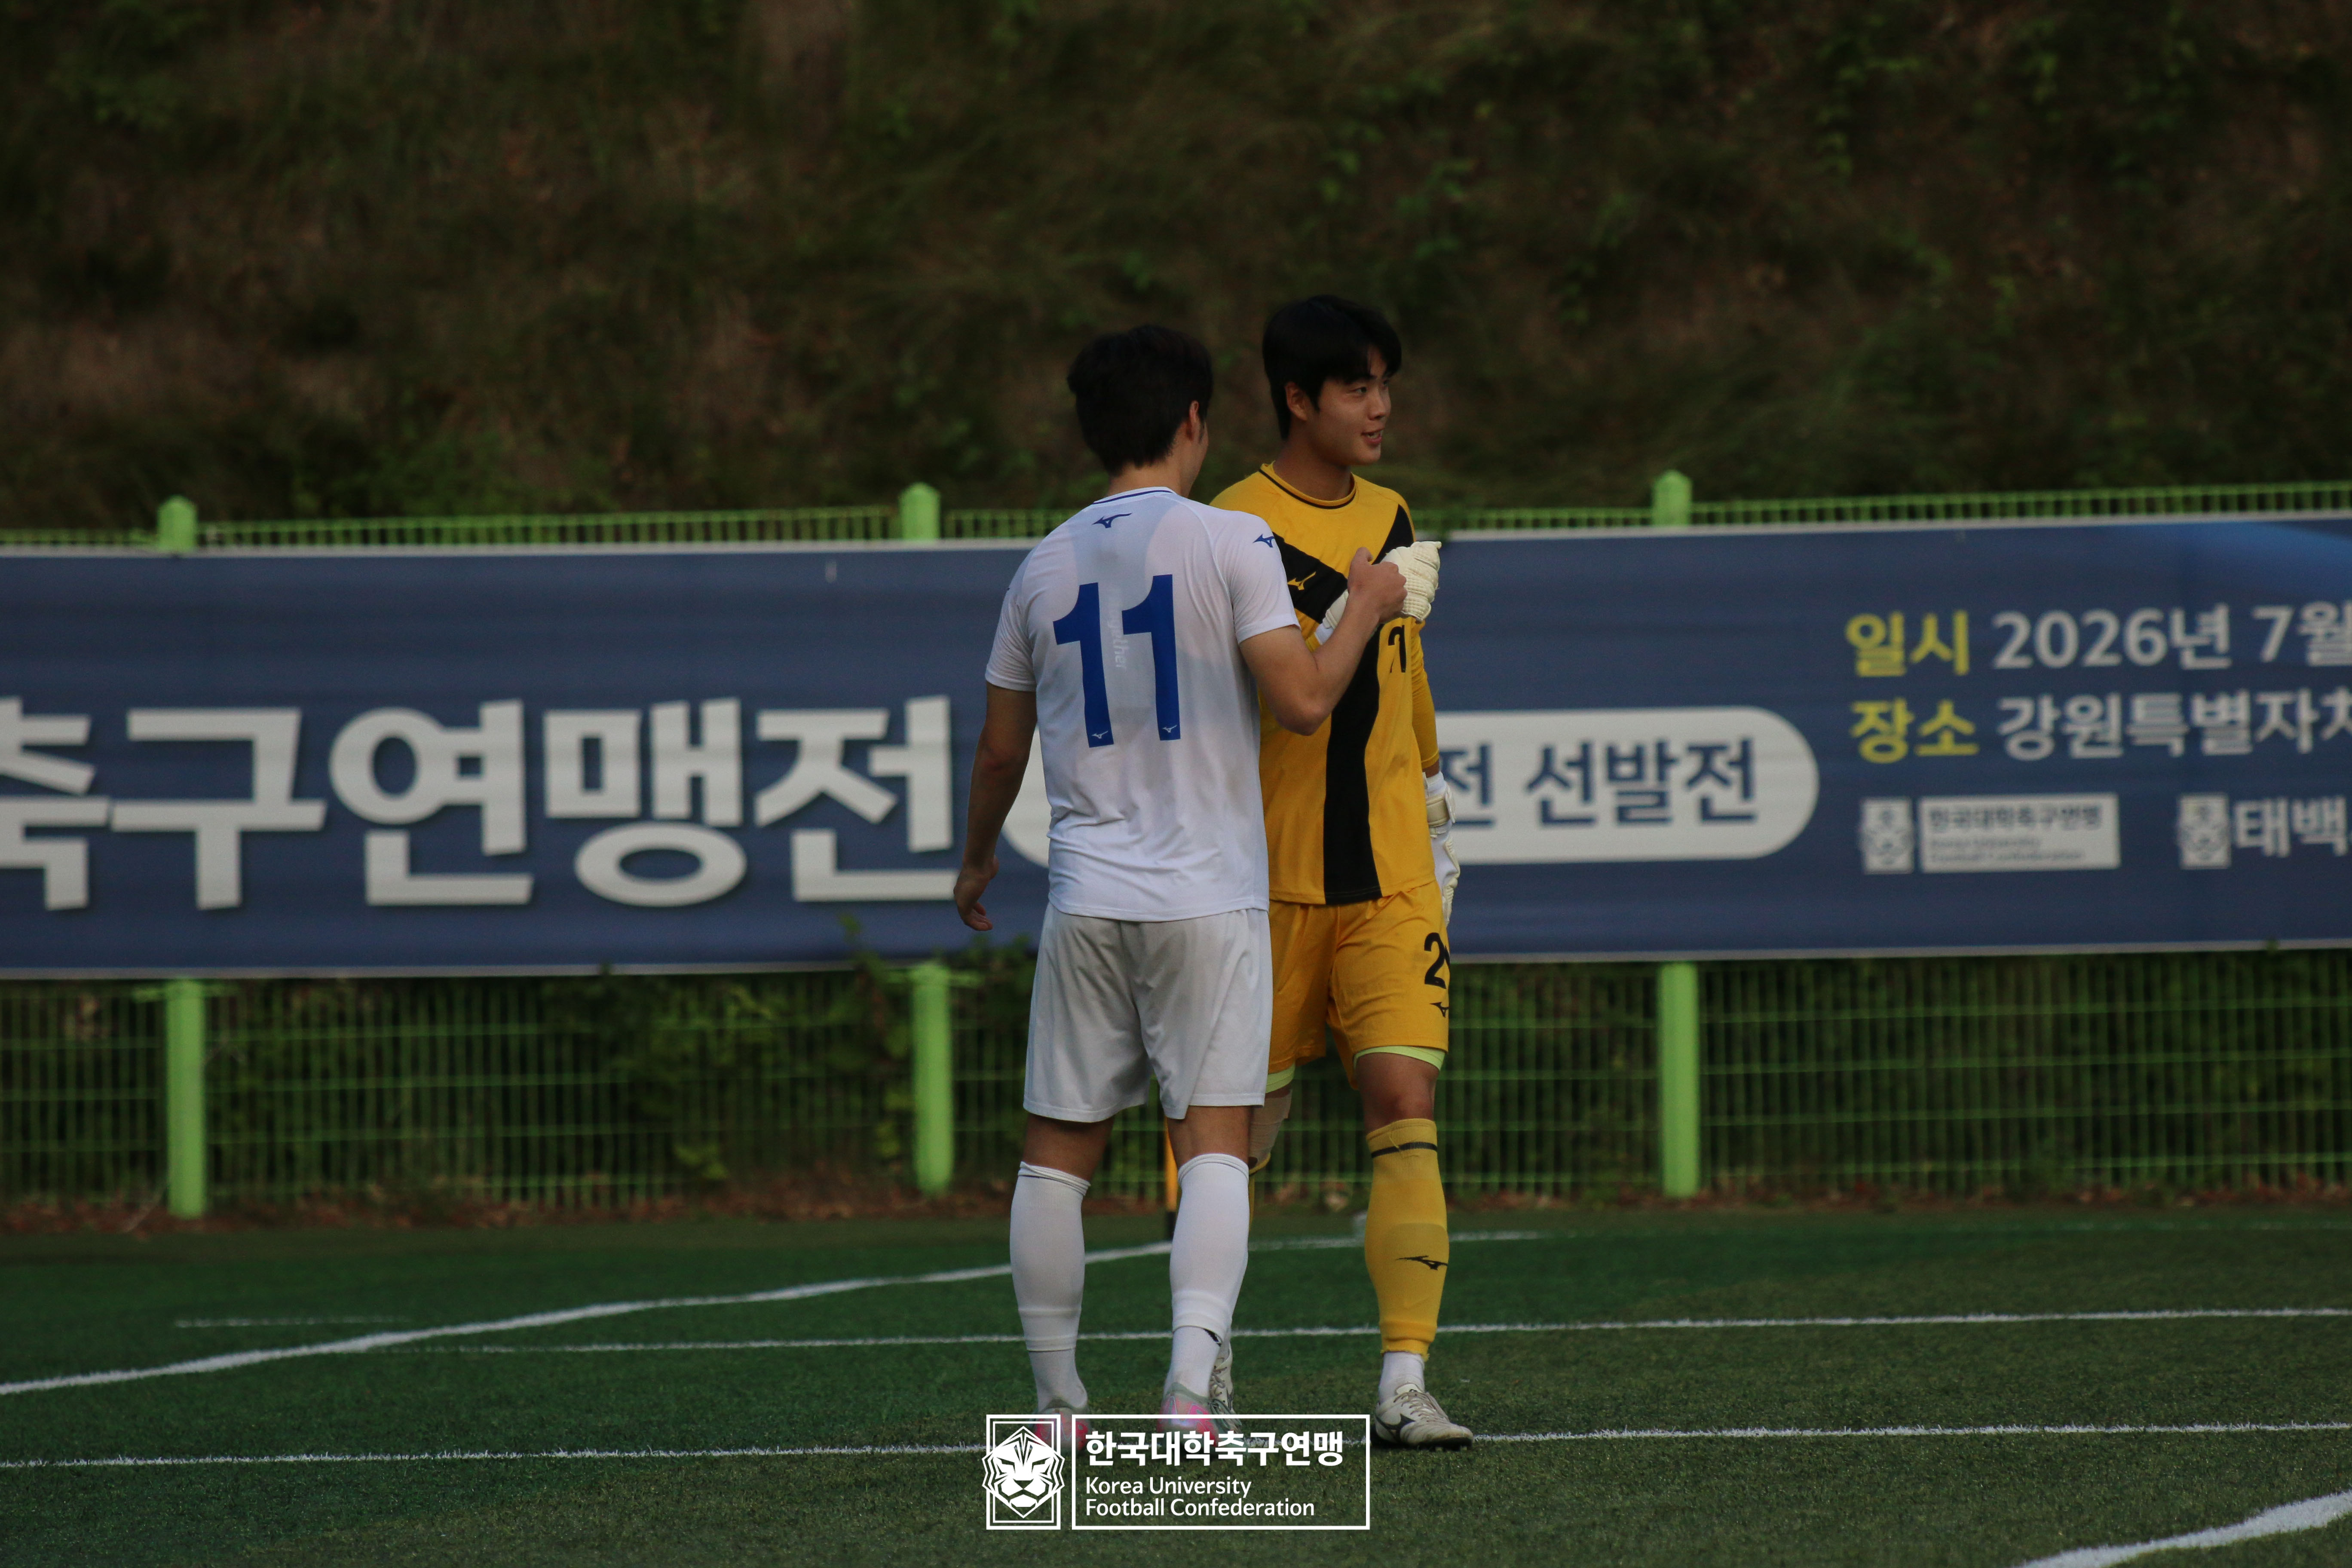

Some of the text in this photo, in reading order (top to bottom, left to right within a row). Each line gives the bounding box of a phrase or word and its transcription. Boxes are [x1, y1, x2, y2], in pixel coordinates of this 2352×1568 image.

[1053, 575, 1180, 748] 11
[1845, 609, 1969, 676] 일시
[1992, 604, 2232, 669] 2026년
[1852, 698, 1978, 763] 장소
[1526, 737, 1756, 827] 선발전
